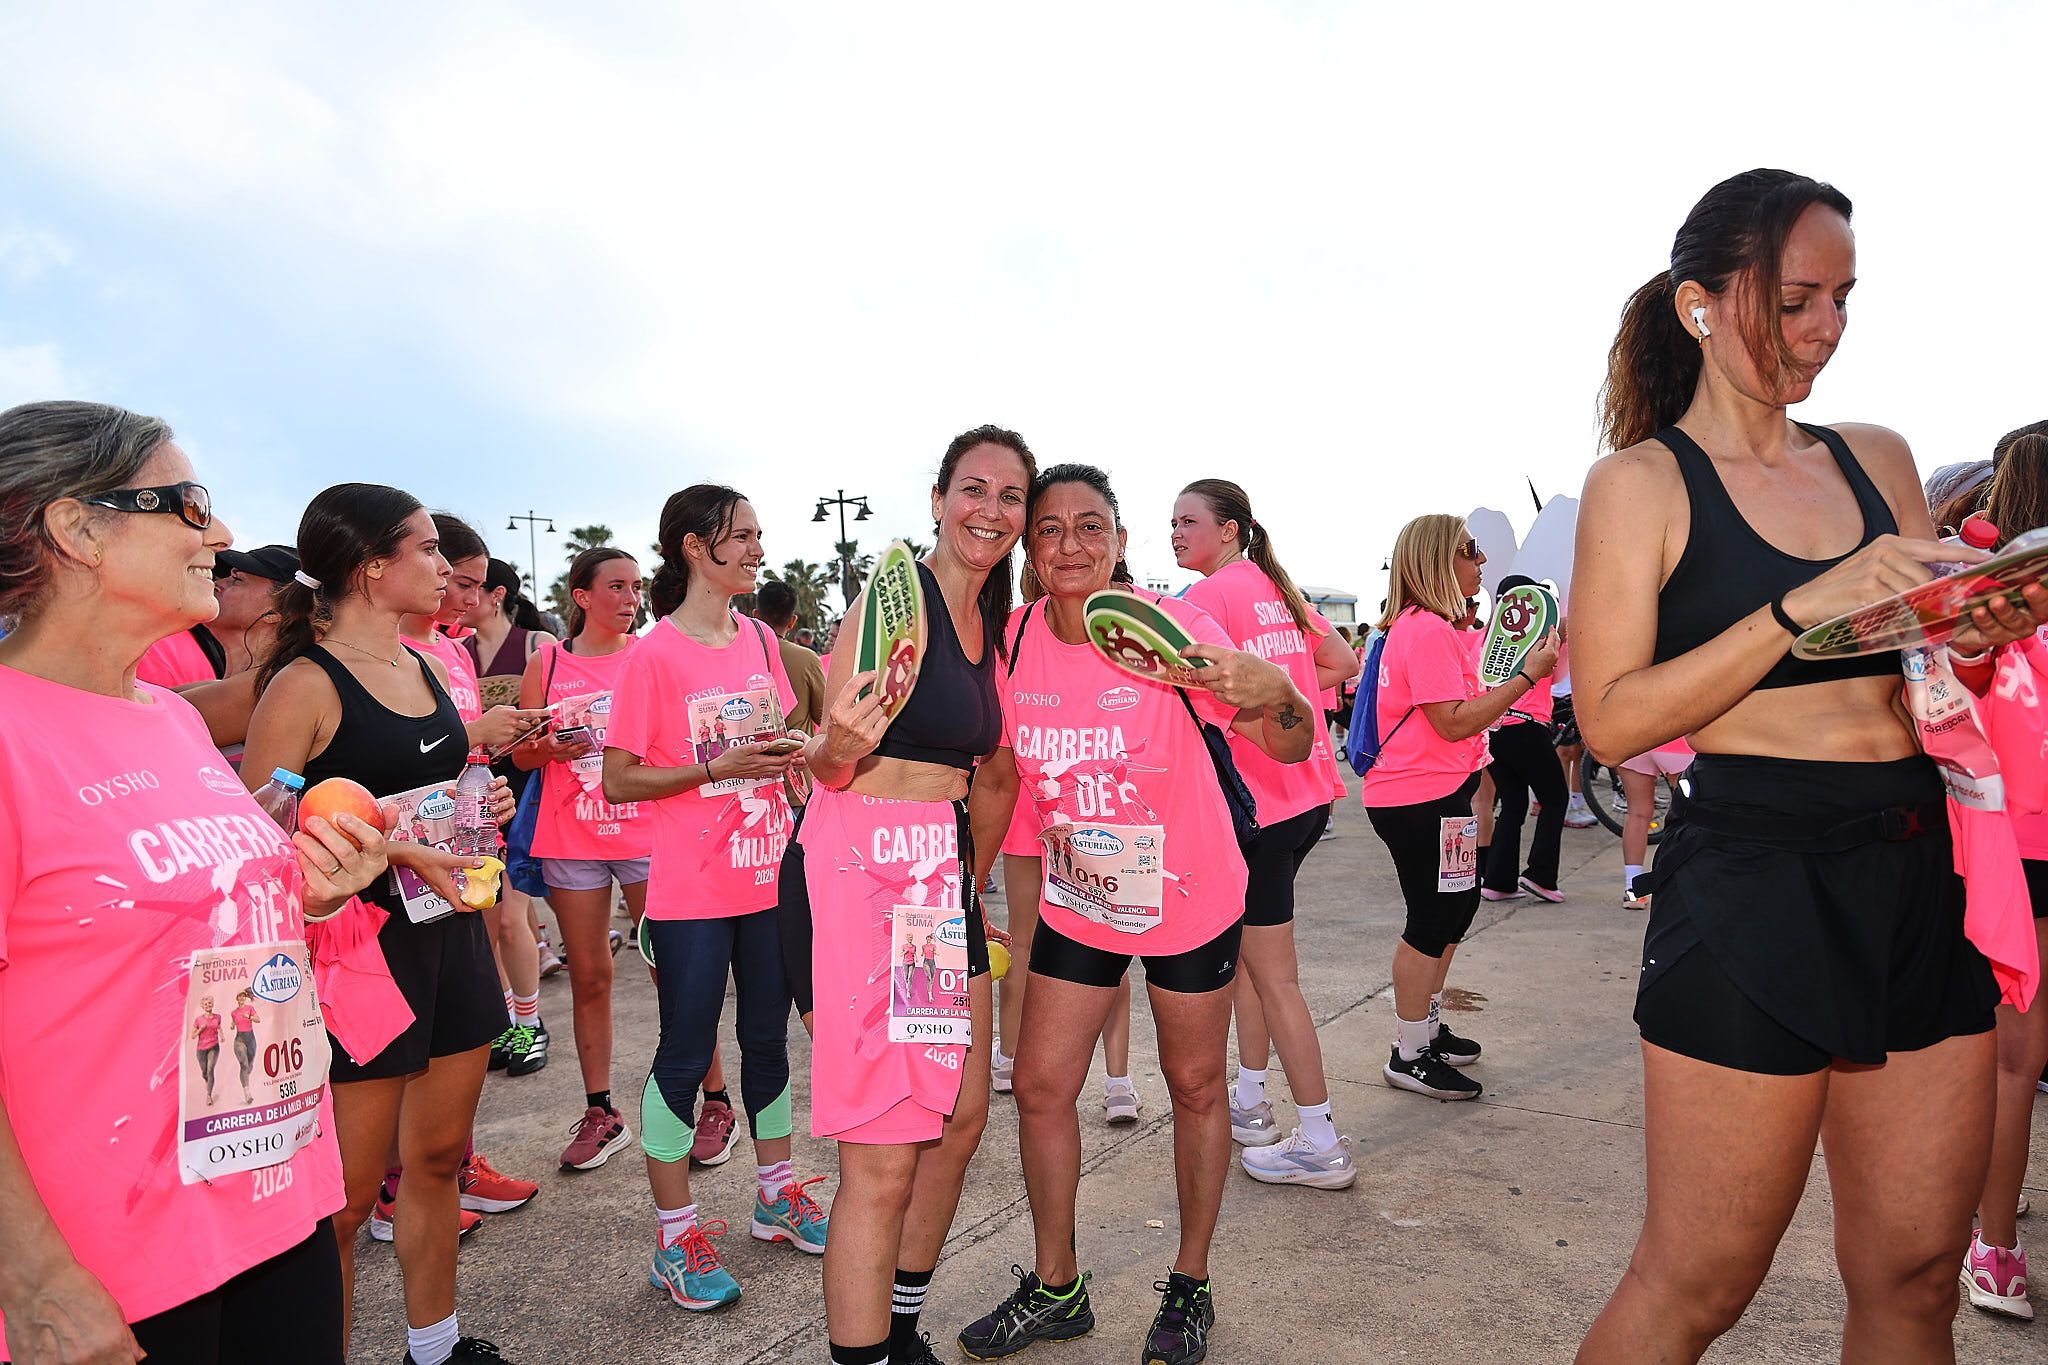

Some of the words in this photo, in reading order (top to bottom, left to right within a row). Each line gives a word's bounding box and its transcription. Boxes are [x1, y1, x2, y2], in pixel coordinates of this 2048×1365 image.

[1484, 635, 1504, 675] CUIDARSE
[1013, 691, 1061, 708] OYSHO
[1015, 724, 1129, 762] CARRERA
[79, 768, 161, 806] OYSHO
[712, 777, 746, 791] OYSHO
[1074, 772, 1117, 818] DE
[597, 822, 622, 836] 2026
[126, 812, 292, 884] CARRERA
[1071, 836, 1120, 852] ASTURIANA
[754, 867, 775, 887] 2026
[1074, 867, 1119, 893] 016
[1057, 891, 1090, 912] OYSHO
[1116, 905, 1147, 915] VALENCIA
[906, 918, 934, 928] SUMA
[1109, 915, 1147, 929] Santander
[202, 965, 249, 985] SUMA
[260, 973, 300, 993] ASTURIANA
[906, 1007, 939, 1016] CARRERA
[940, 1008, 950, 1016] DE
[951, 1008, 960, 1017] LA
[906, 1023, 953, 1035] OYSHO
[263, 1037, 304, 1078] 016
[923, 1046, 958, 1070] 2026
[279, 1079, 298, 1100] 5383
[205, 1110, 263, 1133] CARRERA
[266, 1107, 279, 1121] DE
[279, 1104, 289, 1117] LA
[208, 1132, 284, 1164] OYSHO
[251, 1161, 293, 1204] 2026
